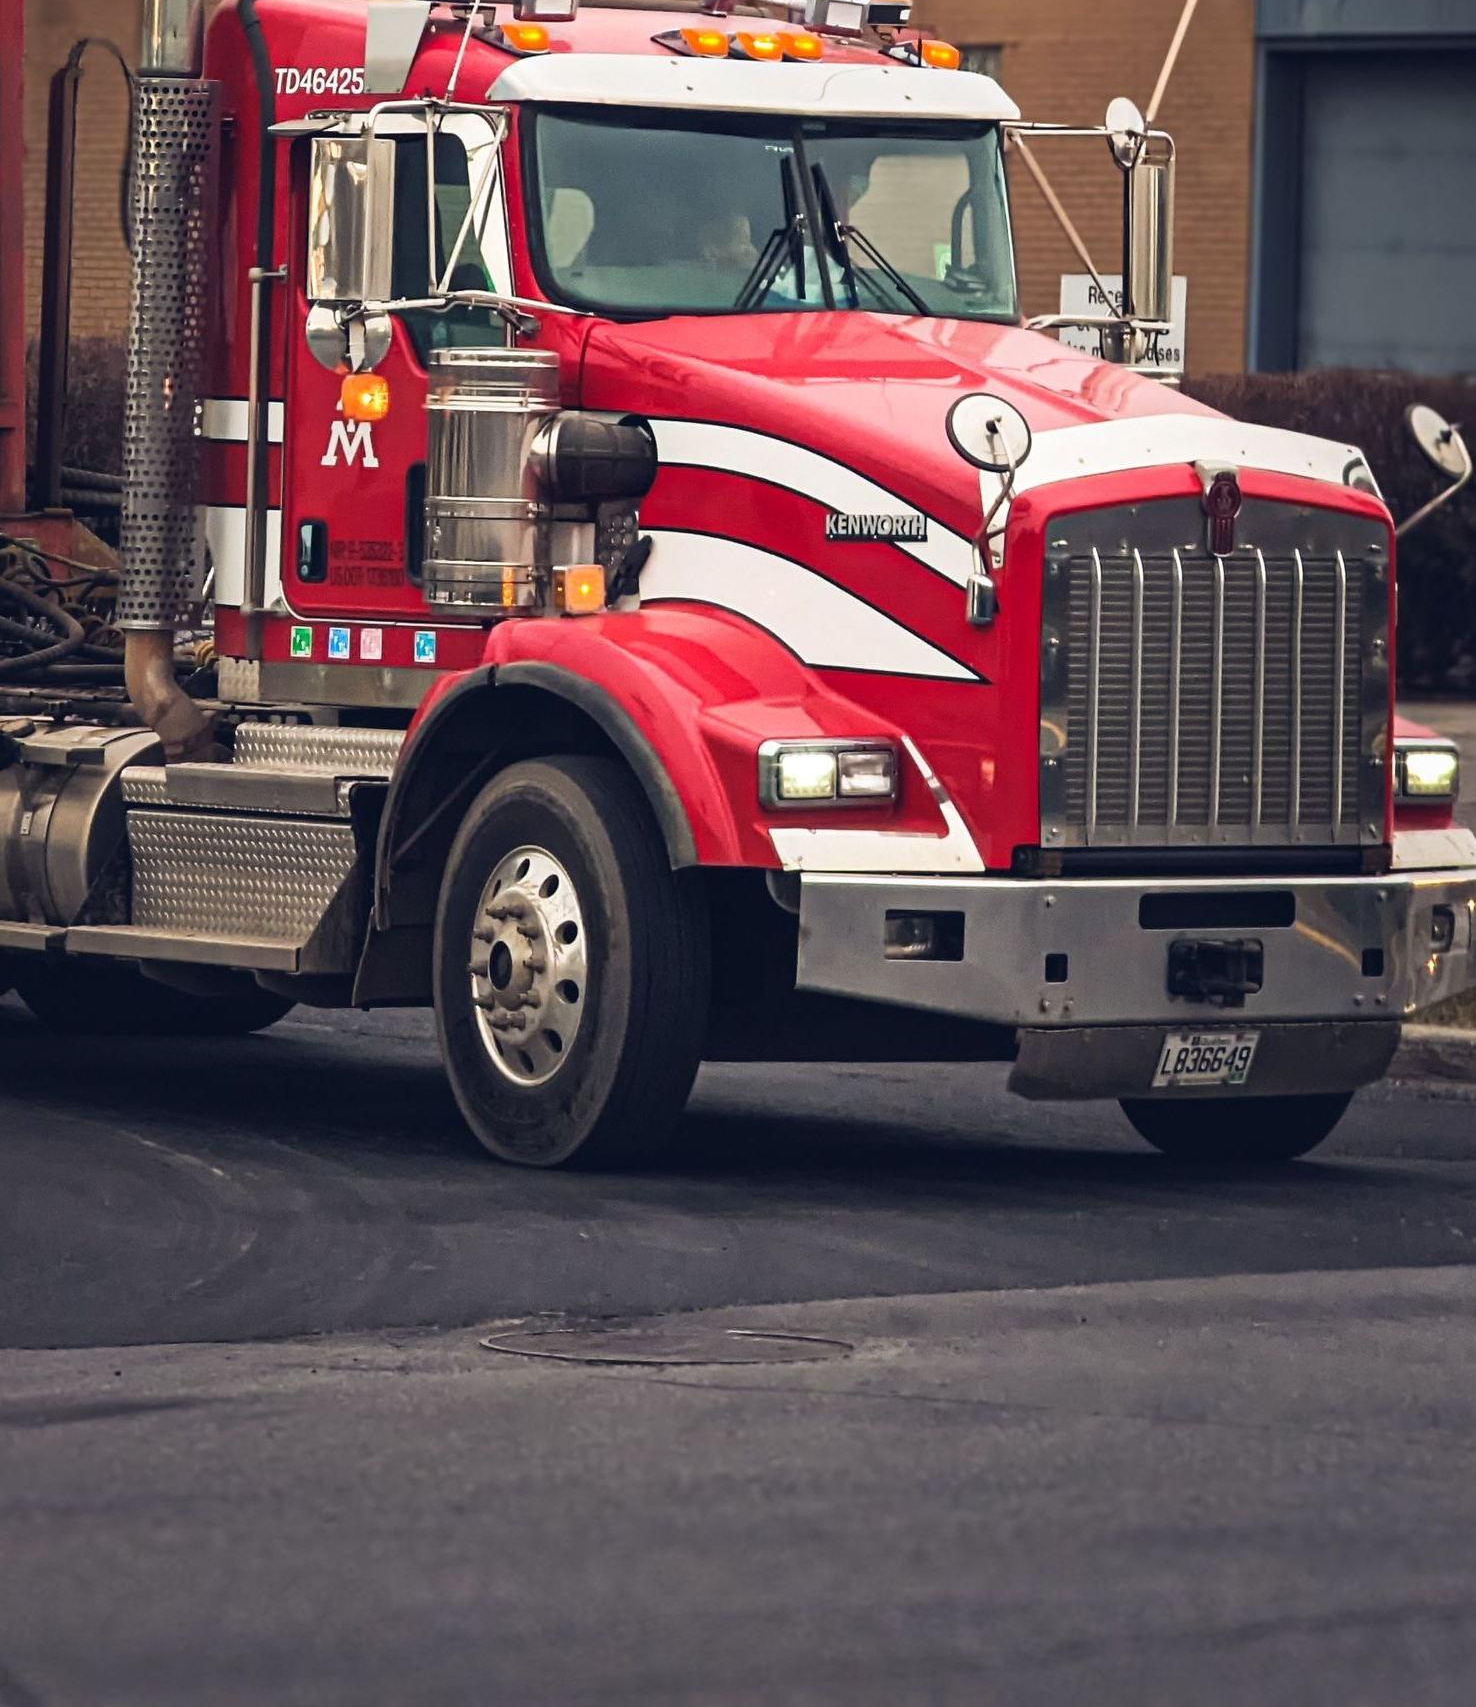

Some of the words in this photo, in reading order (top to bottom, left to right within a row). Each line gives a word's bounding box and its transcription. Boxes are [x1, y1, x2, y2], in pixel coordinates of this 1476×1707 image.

[275, 67, 365, 94] TD46425
[825, 513, 926, 536] KENWORTH
[1160, 1045, 1252, 1075] L836649
